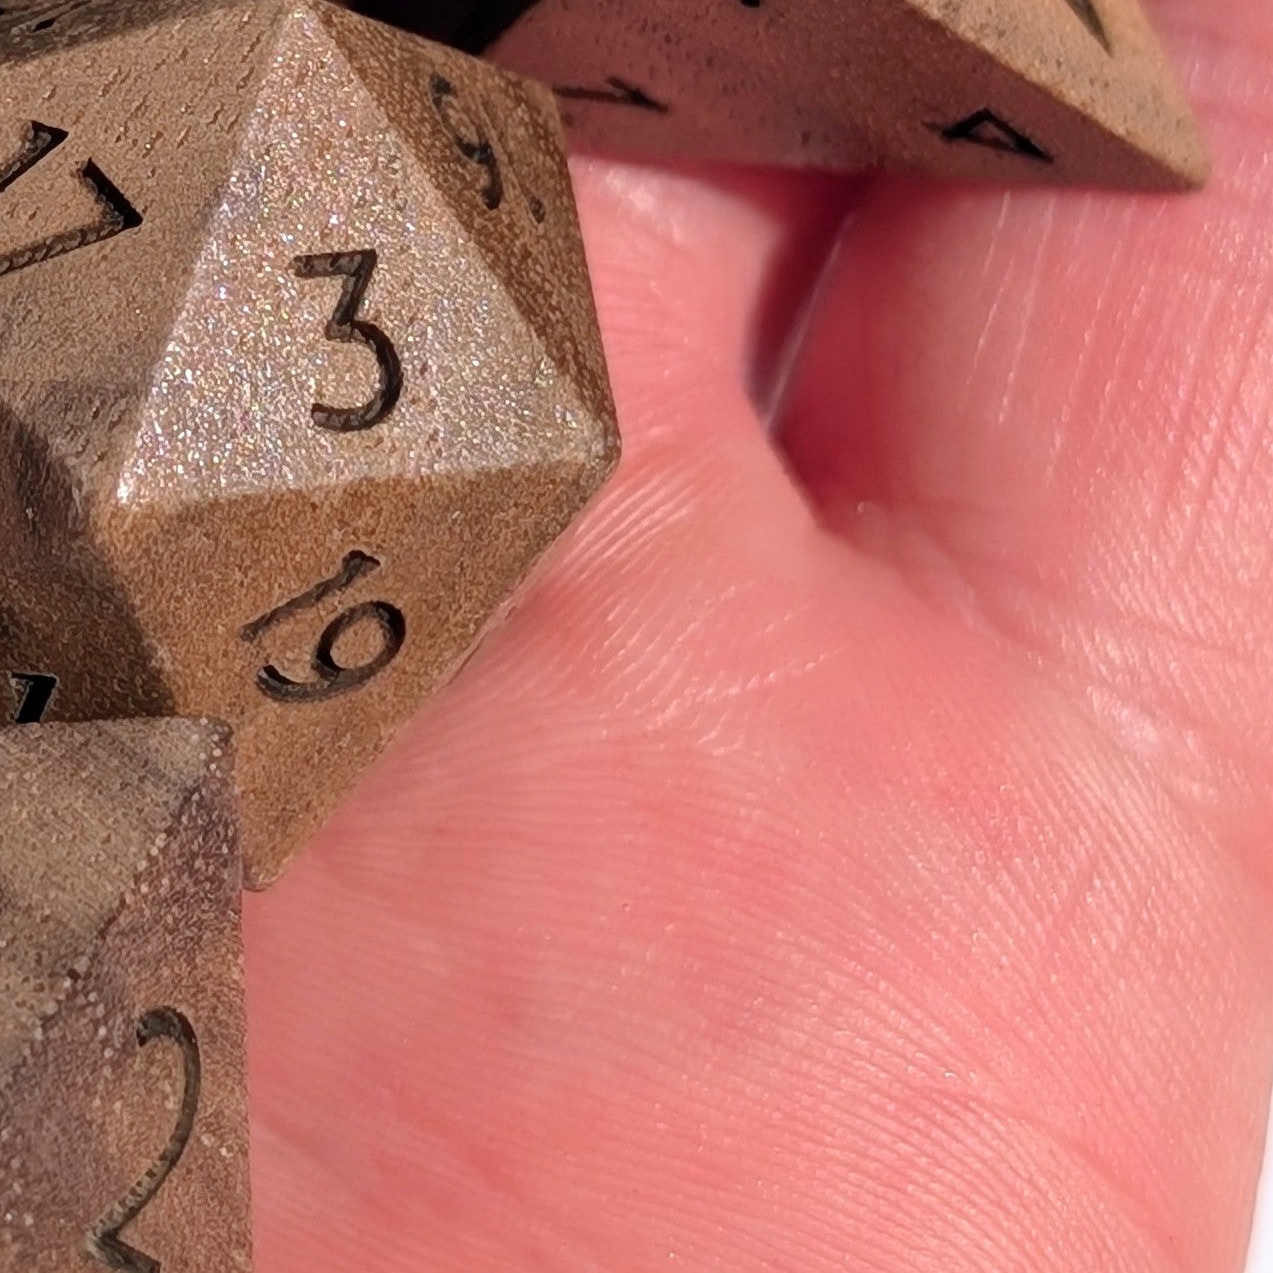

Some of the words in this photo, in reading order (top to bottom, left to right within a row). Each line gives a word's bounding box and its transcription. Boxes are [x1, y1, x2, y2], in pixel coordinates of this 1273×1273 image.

[293, 247, 402, 432] 3
[240, 549, 406, 703] 19
[90, 1005, 201, 1272] 2
